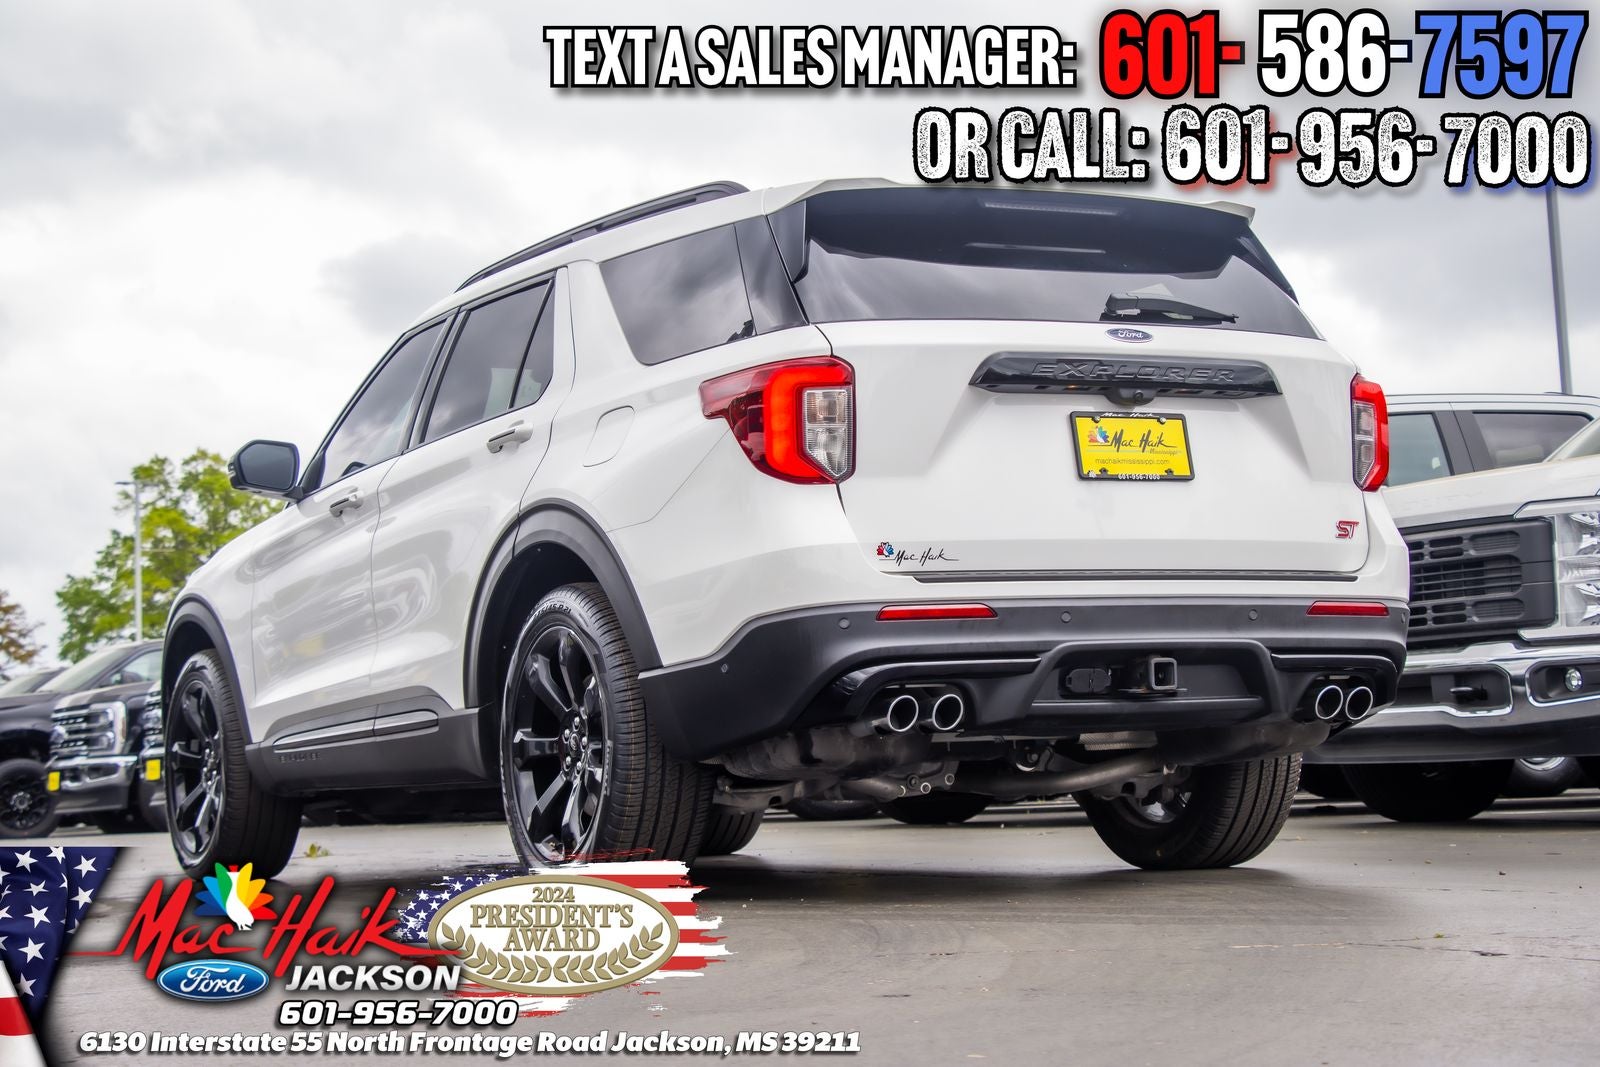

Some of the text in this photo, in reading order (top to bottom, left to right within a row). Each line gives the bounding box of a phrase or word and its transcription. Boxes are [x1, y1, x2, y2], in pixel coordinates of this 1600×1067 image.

[1031, 360, 1235, 383] EXPLORER
[1110, 429, 1177, 453] Mac Haik
[1335, 520, 1360, 539] ST
[894, 547, 958, 567] Mac Haik
